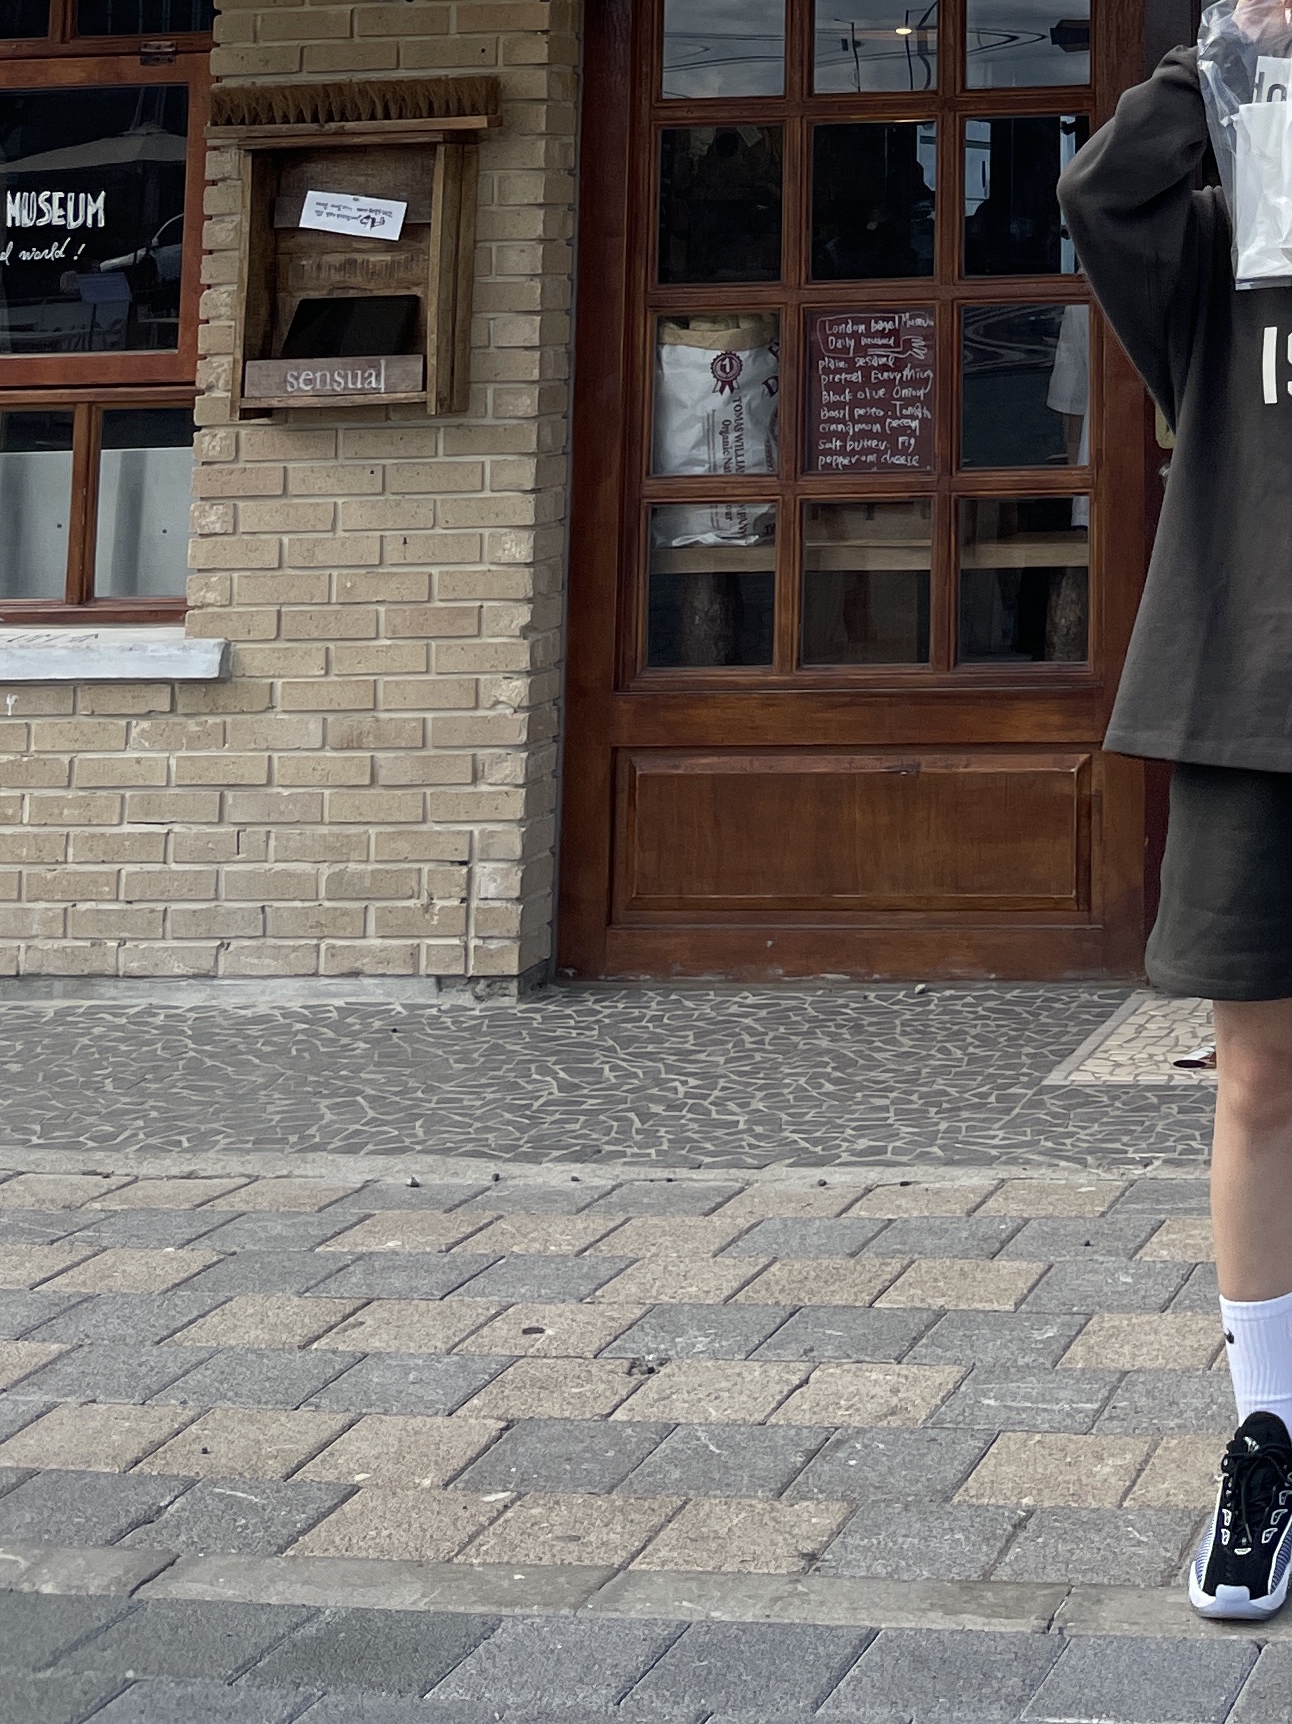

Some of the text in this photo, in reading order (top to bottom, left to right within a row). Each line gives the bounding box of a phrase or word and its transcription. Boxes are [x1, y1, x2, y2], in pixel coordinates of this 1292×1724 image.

[6, 190, 106, 230] MUSEUM
[825, 318, 866, 334] London
[828, 336, 855, 357] Daily
[286, 358, 386, 393] sensual
